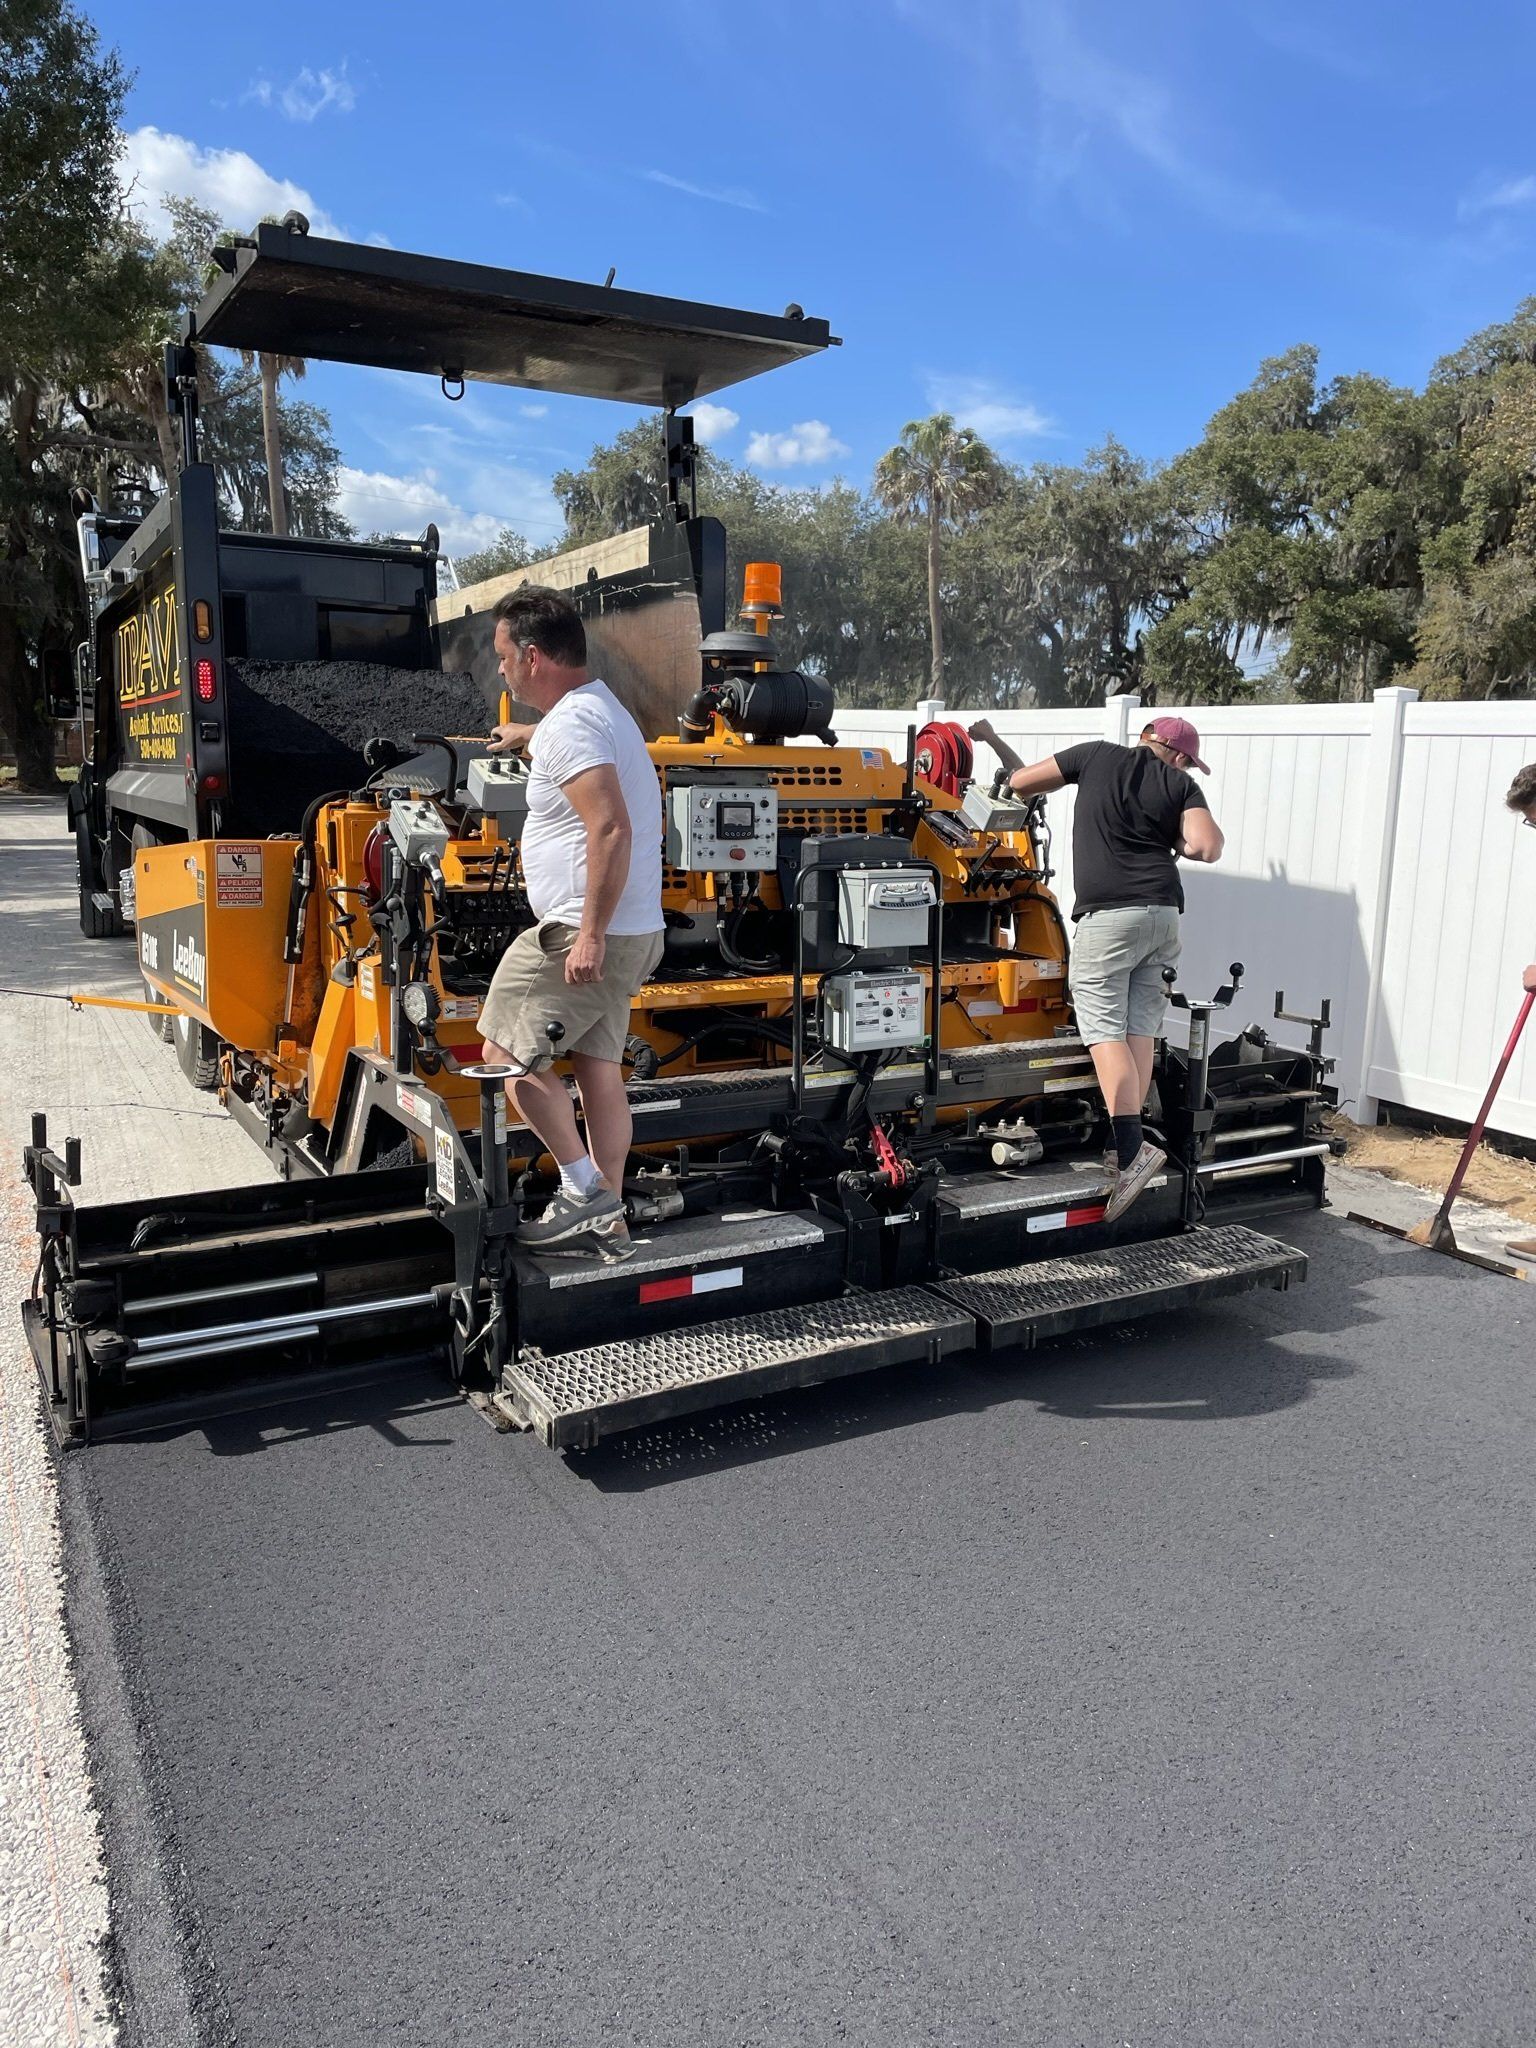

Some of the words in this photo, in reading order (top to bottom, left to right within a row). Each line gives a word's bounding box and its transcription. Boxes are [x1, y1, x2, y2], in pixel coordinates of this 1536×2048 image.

[227, 846, 259, 854] DANGER
[227, 879, 260, 887] PELIGRO
[228, 892, 260, 900] DANGER
[173, 928, 205, 1004] LeeBoy
